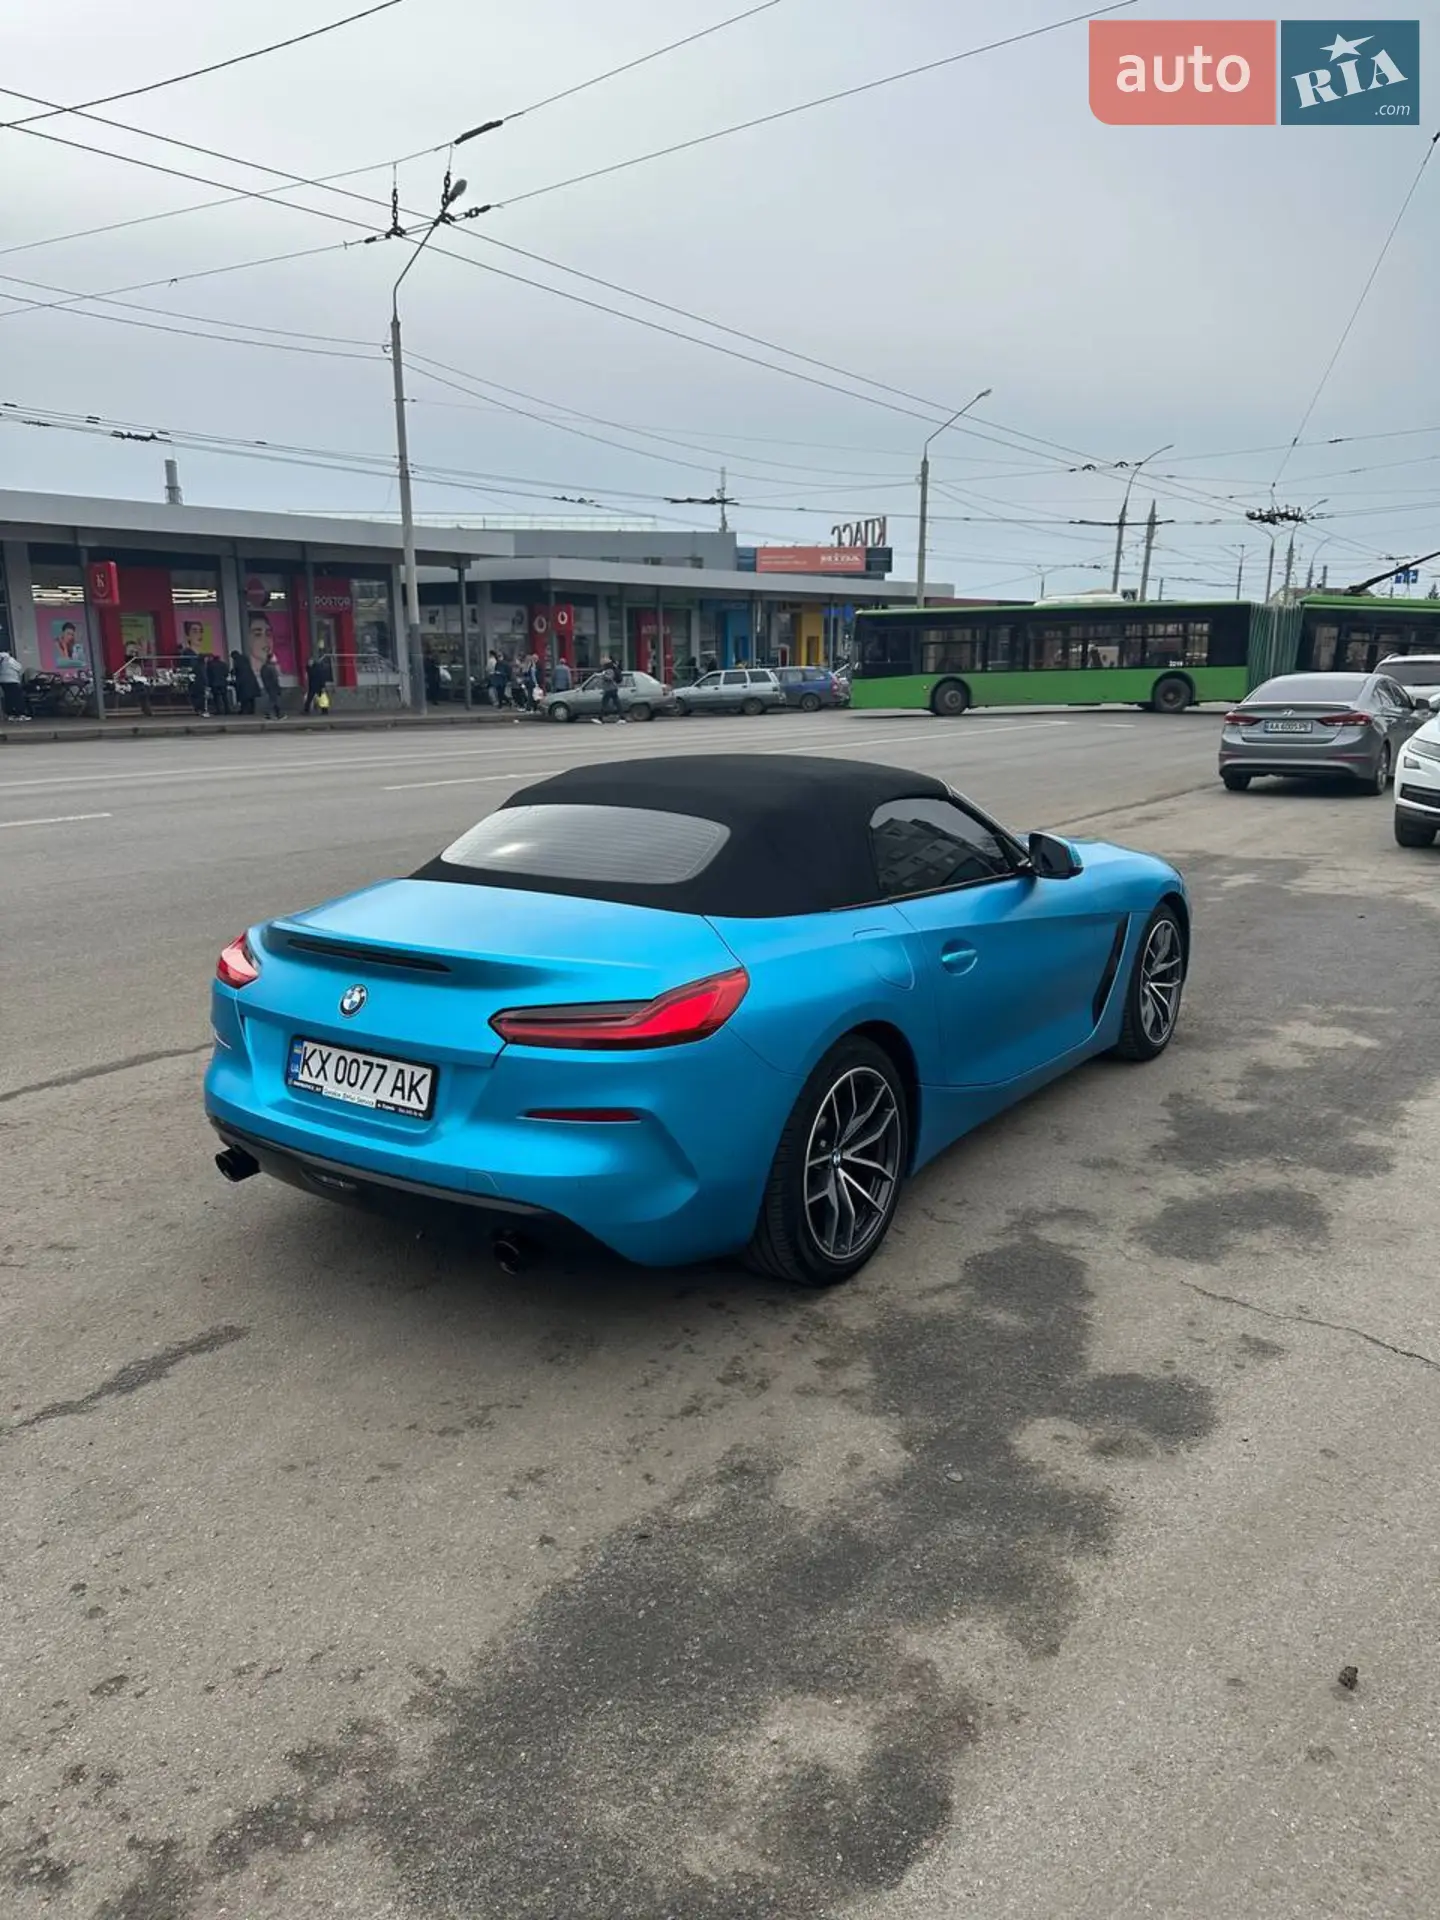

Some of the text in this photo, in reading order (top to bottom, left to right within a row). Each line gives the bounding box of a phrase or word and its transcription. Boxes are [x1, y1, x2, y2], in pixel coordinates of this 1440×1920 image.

[300, 1046, 428, 1105] KX 0077 AK
